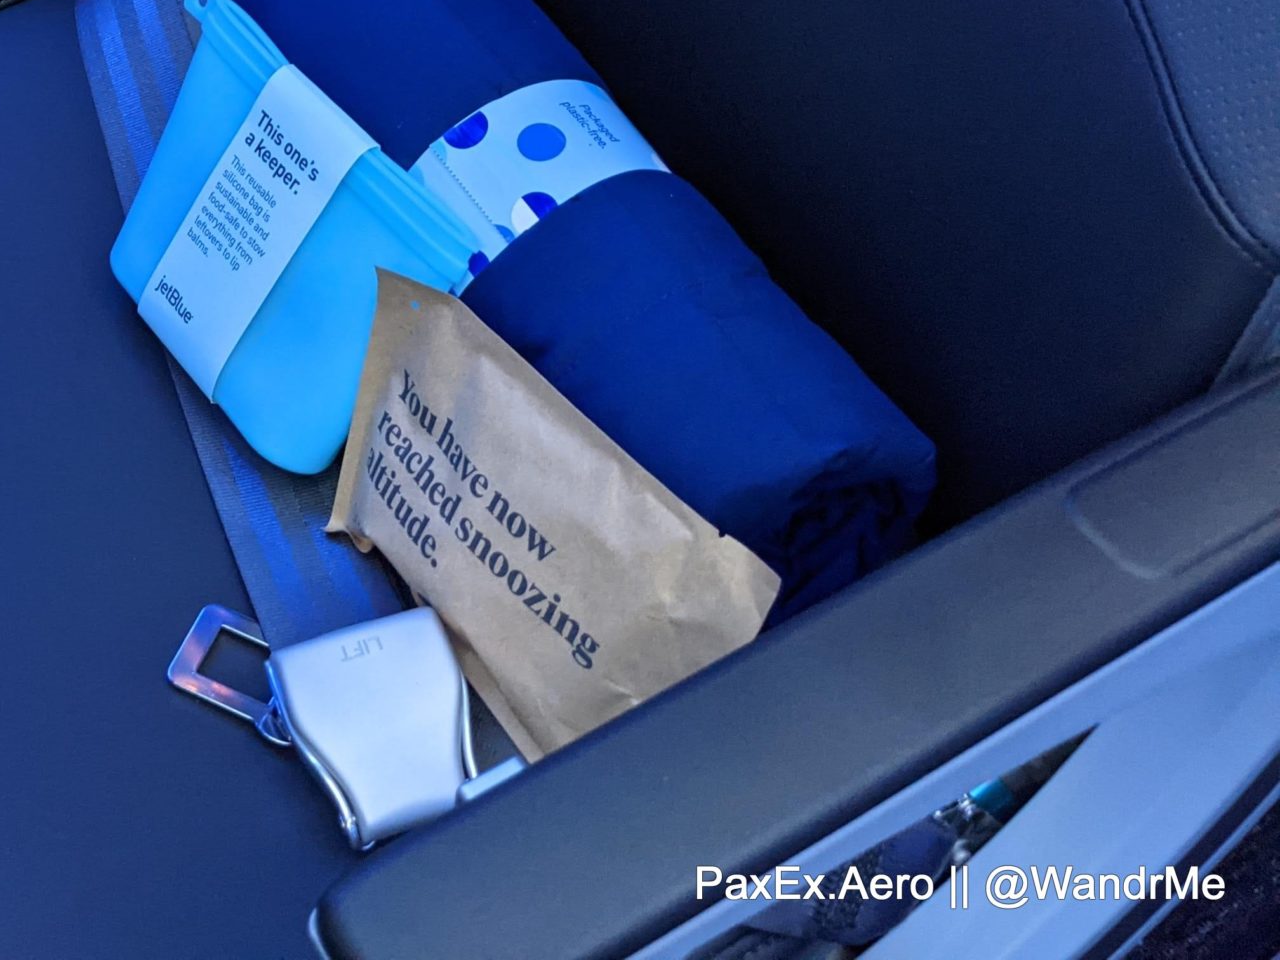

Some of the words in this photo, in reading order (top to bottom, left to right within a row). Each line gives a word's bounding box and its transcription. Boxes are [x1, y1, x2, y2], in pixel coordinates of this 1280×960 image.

[244, 131, 255, 147] a
[254, 139, 301, 195] keeper.
[257, 109, 285, 147] This
[283, 142, 320, 182] one's
[215, 181, 255, 227] sustainable
[253, 221, 270, 241] and
[222, 168, 250, 201] silicone
[248, 196, 264, 217] bag
[262, 210, 271, 223] is
[230, 154, 247, 176] This
[245, 170, 277, 208] reusable
[187, 226, 209, 257] balms.
[194, 215, 224, 253] leftovers
[222, 247, 232, 260] to
[230, 254, 241, 272] lip
[201, 205, 236, 248] everything
[234, 241, 254, 266] from
[208, 191, 241, 231] food-safe
[239, 226, 249, 240] to
[247, 236, 266, 258] stow
[155, 274, 193, 324] jetBlue
[397, 368, 437, 436] You
[436, 417, 489, 498] have
[486, 490, 557, 562] now
[377, 409, 463, 526] reached
[455, 514, 601, 670] snoozing
[341, 636, 383, 662] LIFT
